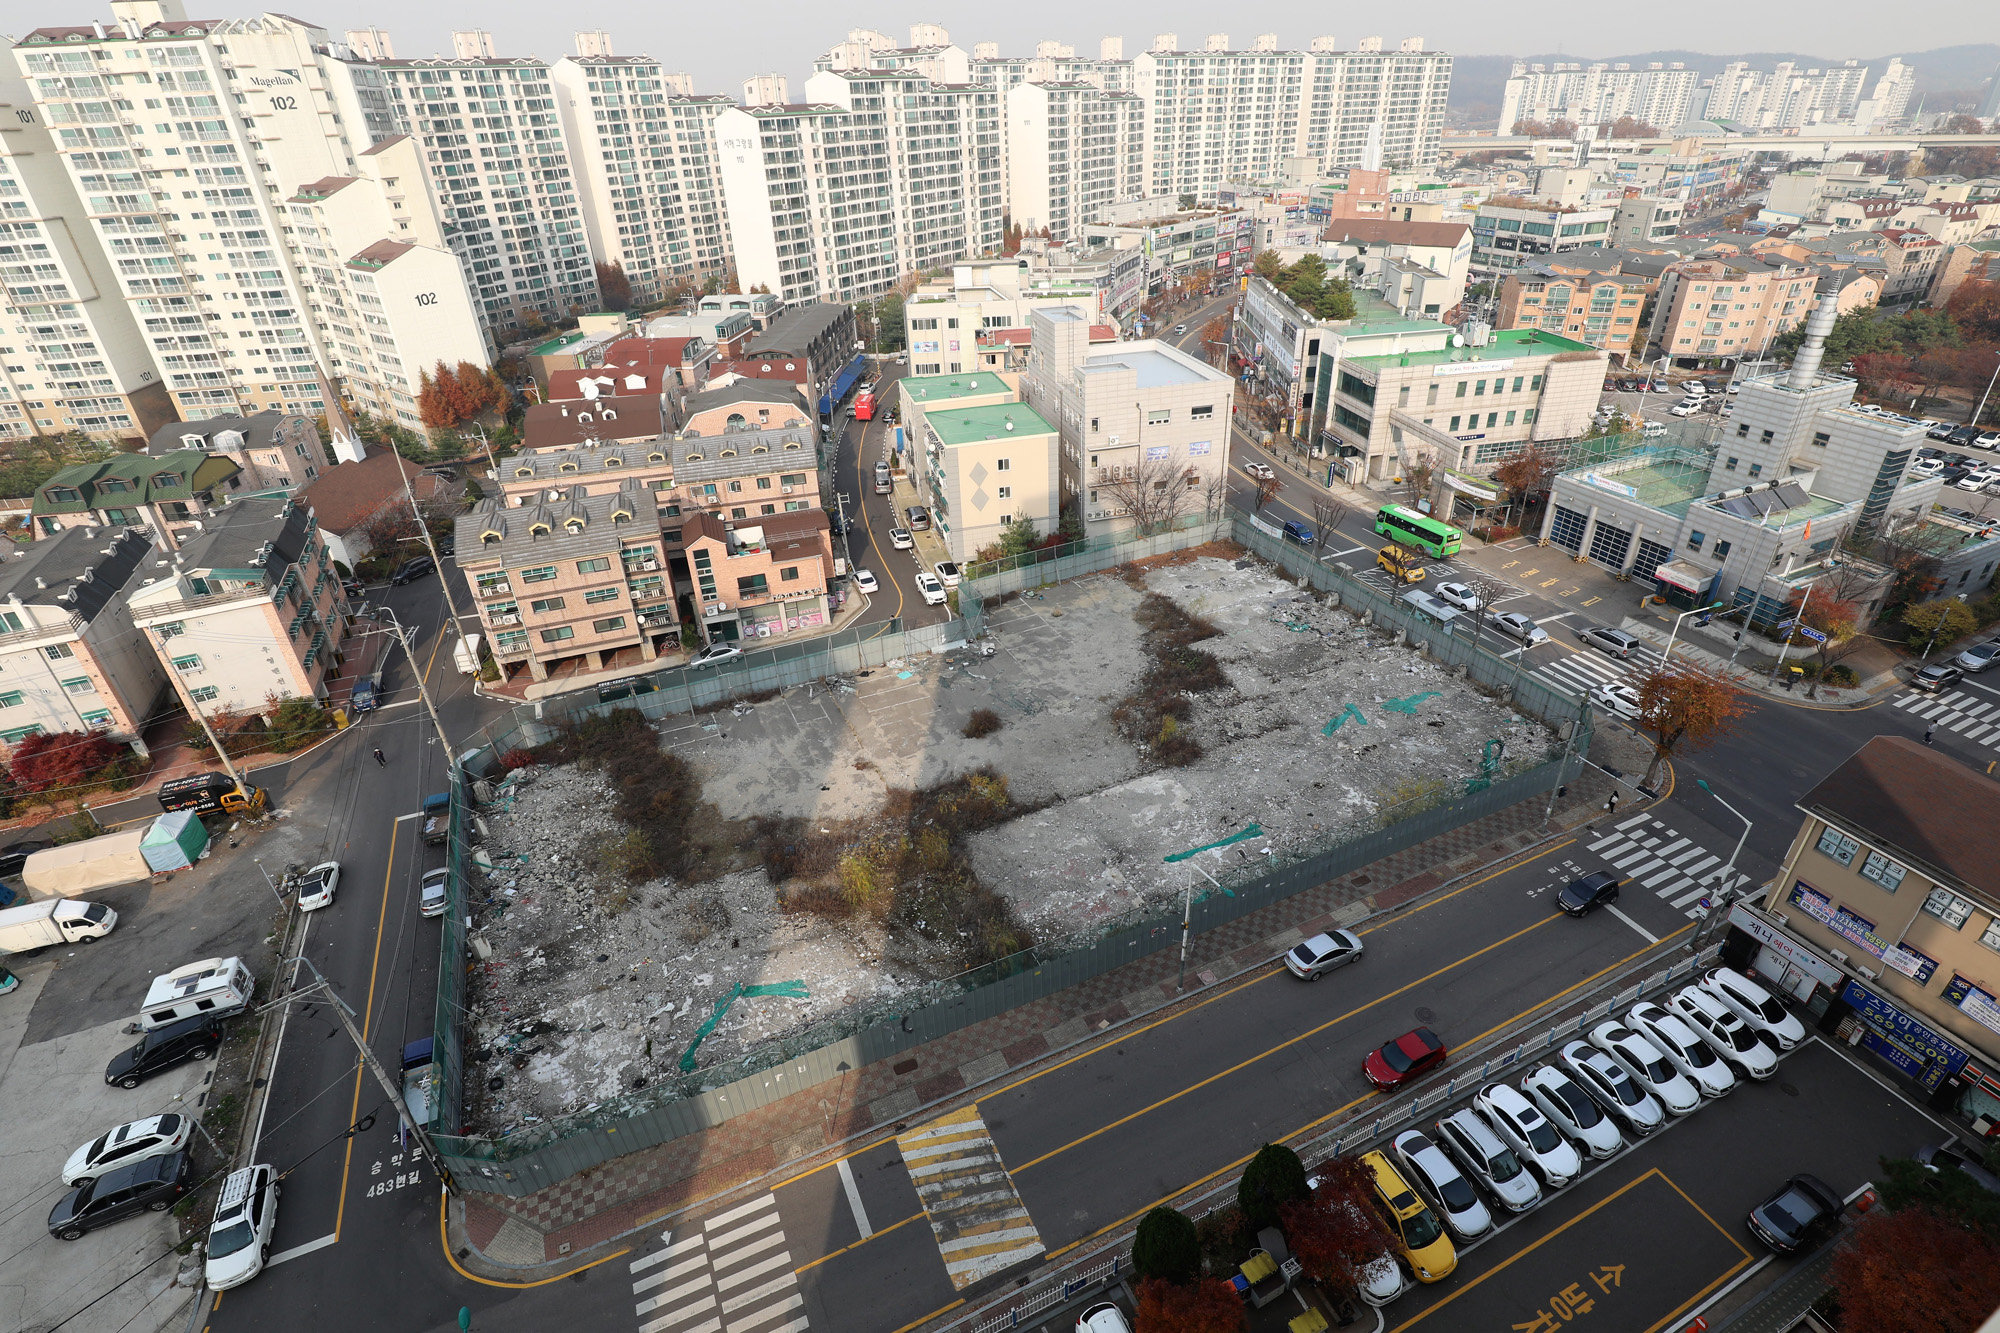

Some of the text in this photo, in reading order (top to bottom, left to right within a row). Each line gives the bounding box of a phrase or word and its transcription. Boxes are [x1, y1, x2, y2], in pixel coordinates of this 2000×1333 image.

[250, 74, 294, 87] Magellan
[269, 96, 298, 110] 102
[16, 110, 35, 123] 101
[415, 292, 438, 307] 102
[139, 370, 153, 382] 101
[1868, 867, 1892, 886] 피아노
[1927, 902, 1962, 924] 바이올린
[1748, 921, 1793, 956] 제니 헤어
[1770, 955, 1787, 969] 제니
[1863, 1007, 1948, 1065] 569-0600
[1867, 998, 1957, 1056] 스카이 공인중개사
[371, 1147, 422, 1175] 승학로
[366, 1170, 420, 1198] 483번길
